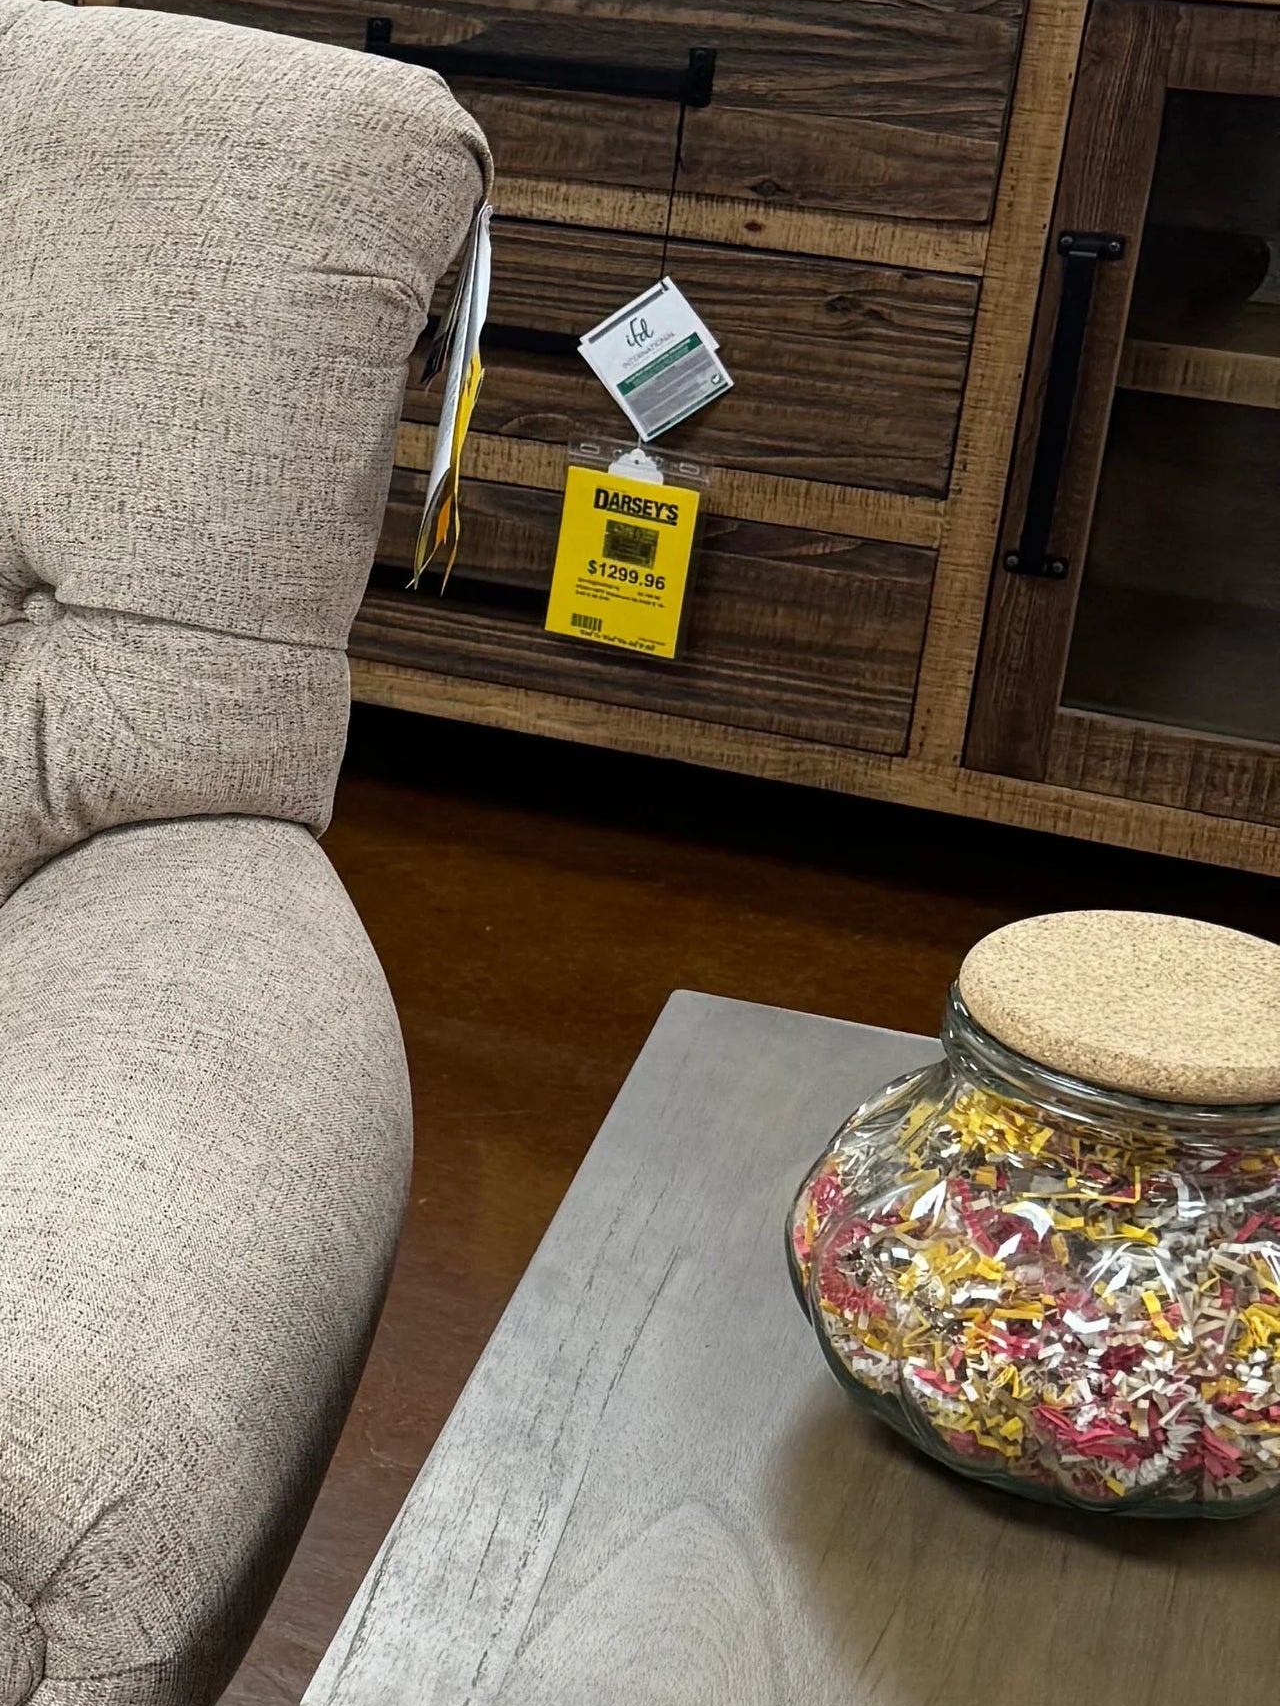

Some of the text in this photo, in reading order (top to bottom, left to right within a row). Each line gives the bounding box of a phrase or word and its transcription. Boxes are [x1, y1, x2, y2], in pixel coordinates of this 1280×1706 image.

[622, 331, 676, 369] INTERNATIONAL
[594, 487, 679, 521] DARSEY'S
[587, 559, 665, 591] $1299.96
